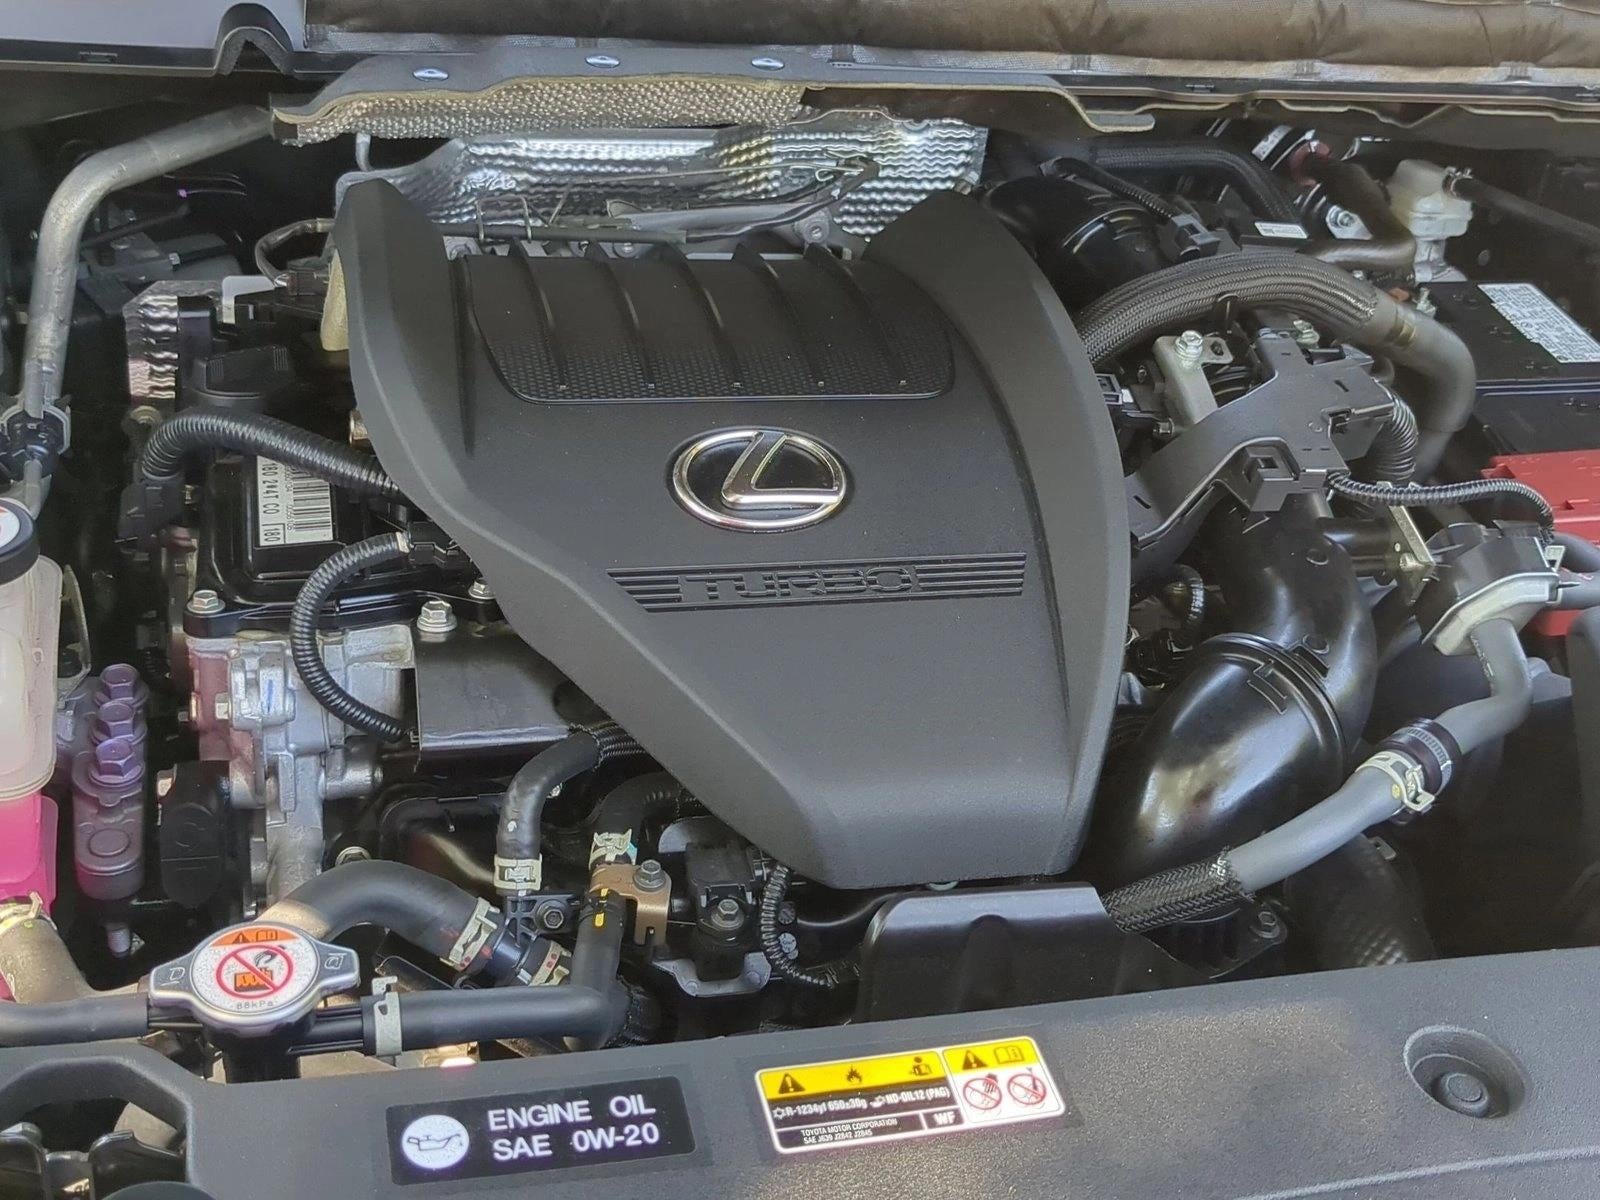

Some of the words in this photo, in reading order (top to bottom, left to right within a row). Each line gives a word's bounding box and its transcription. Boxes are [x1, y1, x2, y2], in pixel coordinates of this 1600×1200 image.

[264, 528, 281, 542] 180
[685, 565, 913, 599] TURBO
[925, 1086, 951, 1101] (PAG)
[487, 1100, 593, 1131] ENGINE
[609, 1094, 657, 1118] OIL
[933, 1111, 956, 1125] WF
[800, 1126, 828, 1136] TOYOTA
[828, 1124, 852, 1134] MOTOR
[852, 1118, 898, 1130] CORPORATION
[493, 1133, 553, 1161] SAE
[571, 1122, 660, 1152] 0W-20
[803, 1136, 817, 1144] SAE
